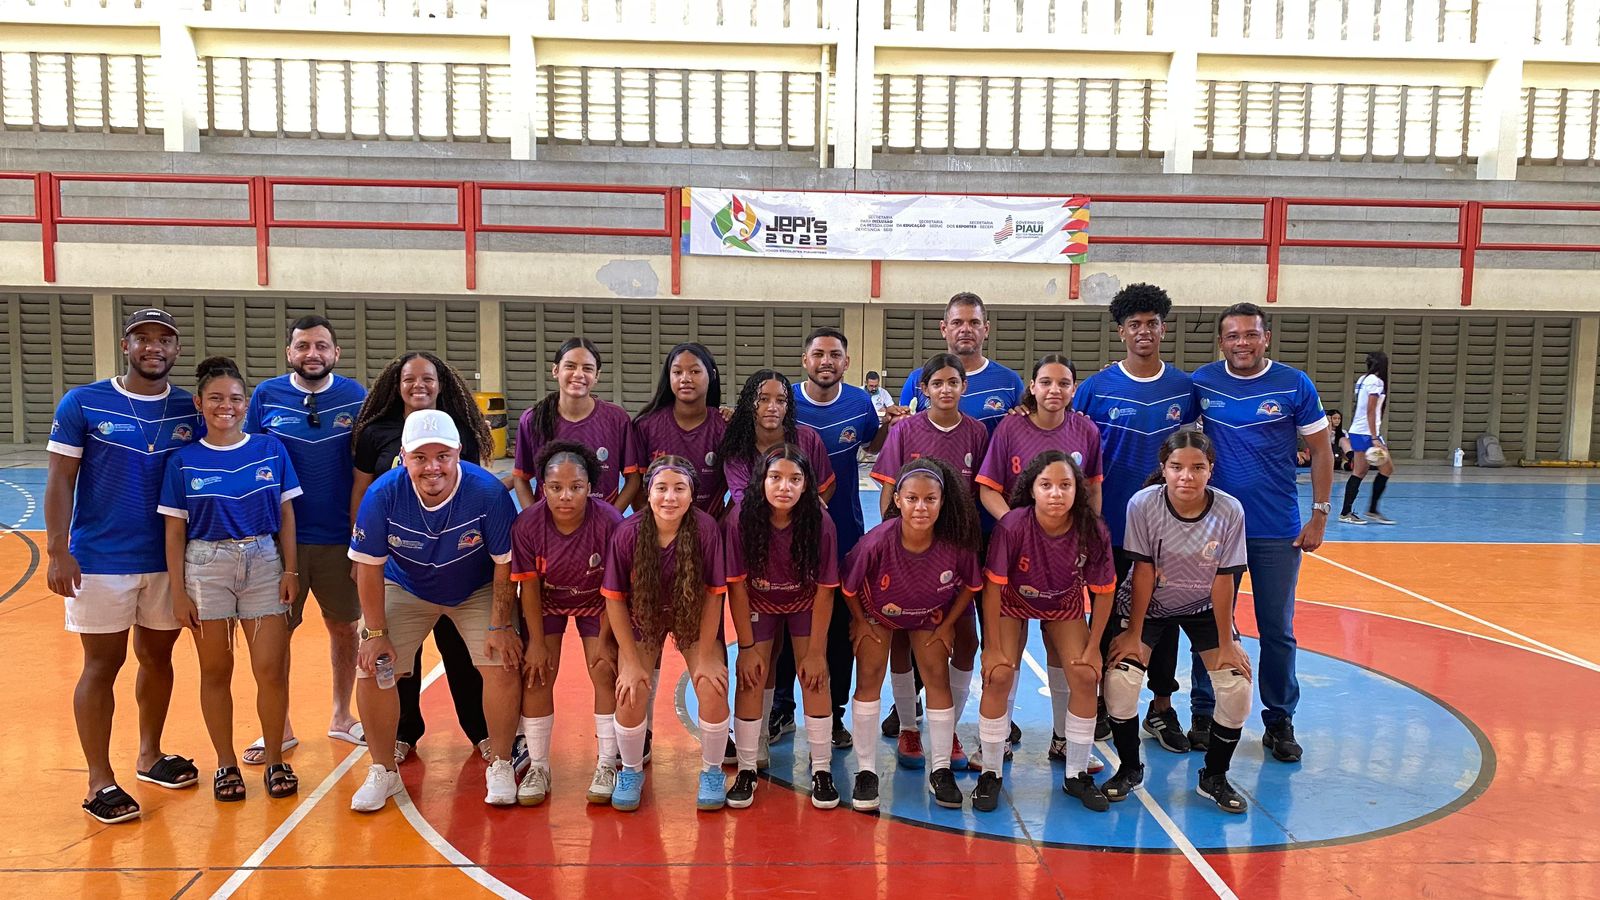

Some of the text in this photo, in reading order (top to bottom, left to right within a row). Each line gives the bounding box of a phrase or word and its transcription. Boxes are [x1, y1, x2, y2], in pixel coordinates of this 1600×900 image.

[765, 233, 828, 245] 2025
[1012, 456, 1022, 474] 8
[1019, 556, 1030, 573] 5
[880, 574, 891, 591] 9
